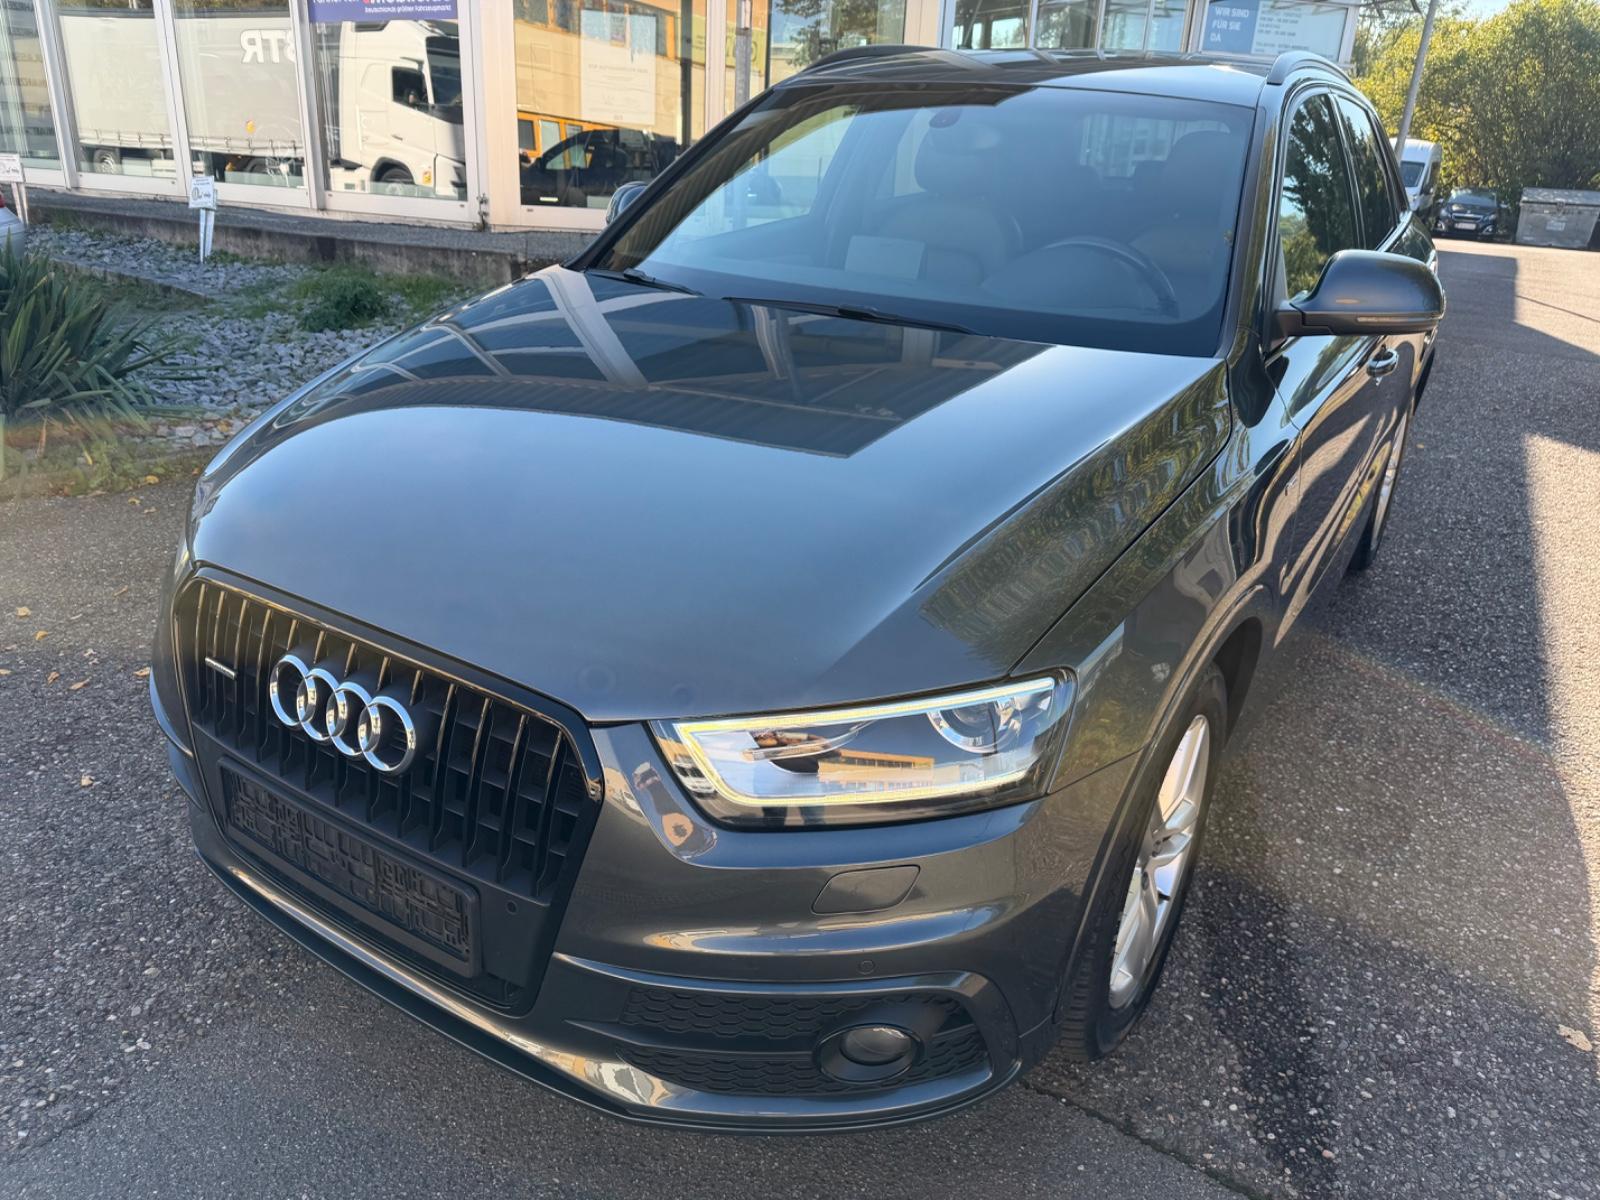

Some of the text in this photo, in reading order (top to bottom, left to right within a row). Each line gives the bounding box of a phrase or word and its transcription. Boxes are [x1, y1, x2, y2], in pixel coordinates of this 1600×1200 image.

[1215, 6, 1230, 17] WIR
[1231, 7, 1249, 18] SIND
[1209, 32, 1222, 42] DA
